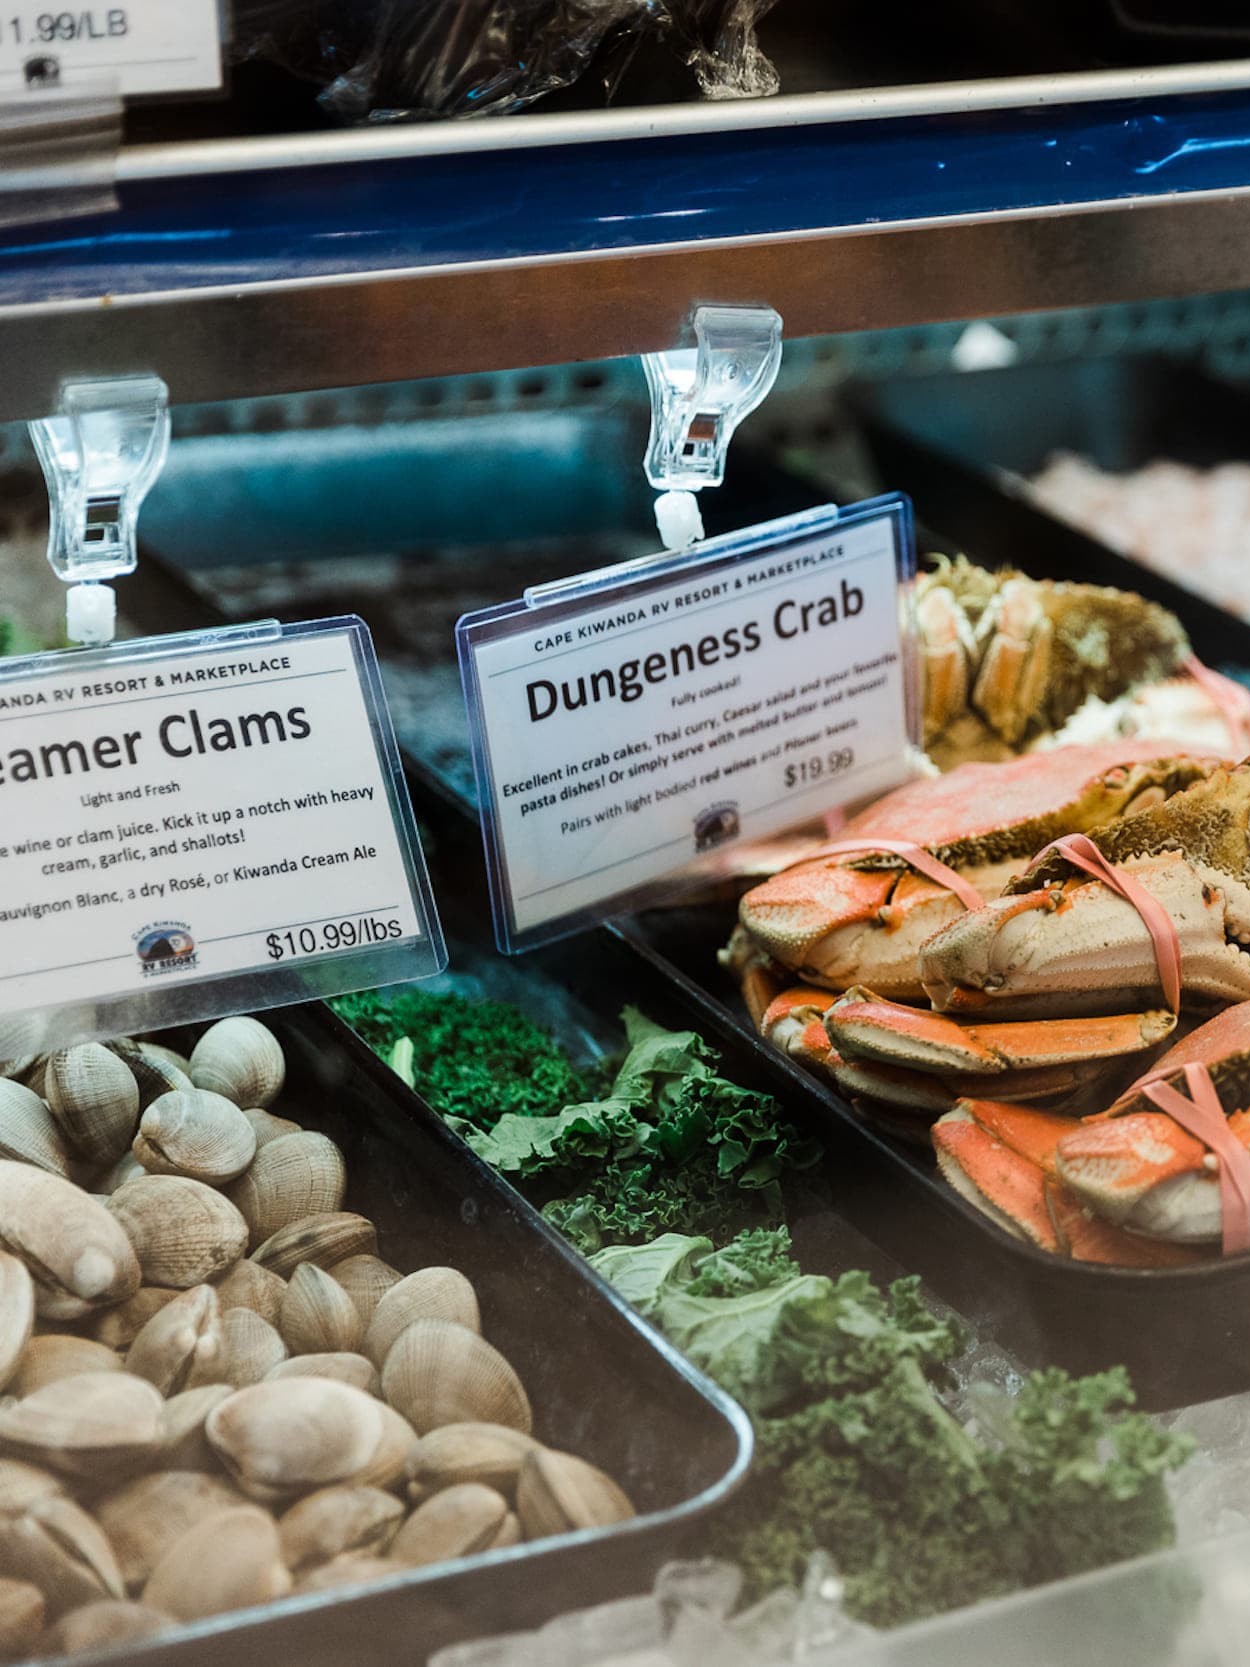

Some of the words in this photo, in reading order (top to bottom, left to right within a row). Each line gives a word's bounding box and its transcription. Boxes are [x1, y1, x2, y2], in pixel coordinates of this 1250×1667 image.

[0, 8, 129, 46] 1.99/LB
[534, 631, 573, 653] CAPE
[577, 608, 647, 639] KIWANDA
[651, 601, 670, 615] RV
[674, 581, 730, 608] RESORT
[734, 578, 743, 590] &
[747, 544, 845, 585] MARKETPLACE
[53, 687, 75, 704] RV
[81, 677, 147, 698] RESORT
[154, 675, 165, 688] &
[170, 656, 292, 685] MARKETPLACE
[525, 620, 762, 722] Dungeness
[773, 578, 865, 640] Crab
[670, 692, 697, 707] Fully
[0, 729, 142, 785] amer
[158, 706, 312, 758] Clams
[502, 768, 564, 798] Excellent
[565, 763, 579, 777] in
[581, 752, 611, 772] crab
[612, 740, 652, 762] cakes,
[654, 726, 682, 745] Thai
[722, 702, 762, 722] Caesar
[765, 686, 796, 707] salad
[800, 678, 821, 695] and
[824, 670, 850, 688] your
[520, 794, 557, 817] pasta
[559, 774, 606, 801] dishes!
[608, 769, 625, 785] Or
[627, 754, 669, 778] simply
[671, 743, 705, 761] serve
[708, 730, 736, 749] with
[737, 714, 780, 738] melted
[782, 700, 819, 721] butter
[822, 690, 843, 707] and
[12, 838, 52, 855] wine
[56, 835, 73, 849] or
[76, 828, 114, 845] clam
[117, 822, 159, 842] juice.
[162, 813, 194, 832] Kick
[196, 811, 209, 826] it
[212, 809, 232, 824] up
[235, 807, 245, 820] a
[248, 798, 291, 818] notch
[294, 791, 328, 810] with
[330, 785, 374, 803] heavy
[80, 792, 113, 808] Light
[117, 786, 142, 802] and
[144, 780, 181, 797] Fresh
[560, 814, 592, 835] Pairs
[594, 804, 623, 824] with
[624, 793, 652, 814] light
[654, 776, 697, 802] bodied
[699, 766, 720, 784] red
[723, 756, 758, 776] wines
[760, 745, 781, 762] and
[41, 857, 96, 876] cream,
[99, 847, 146, 869] garlic,
[149, 839, 178, 858] and
[181, 828, 246, 852] shallots!
[76, 889, 124, 908] Blanc,
[127, 887, 136, 900] a
[139, 882, 165, 898] dry
[168, 872, 211, 892] Rosé,
[213, 871, 230, 885] or
[232, 857, 299, 882] Kiwanda
[301, 850, 350, 870] Cream
[352, 844, 378, 861] Ale
[265, 916, 403, 960] $10.99/lbs
